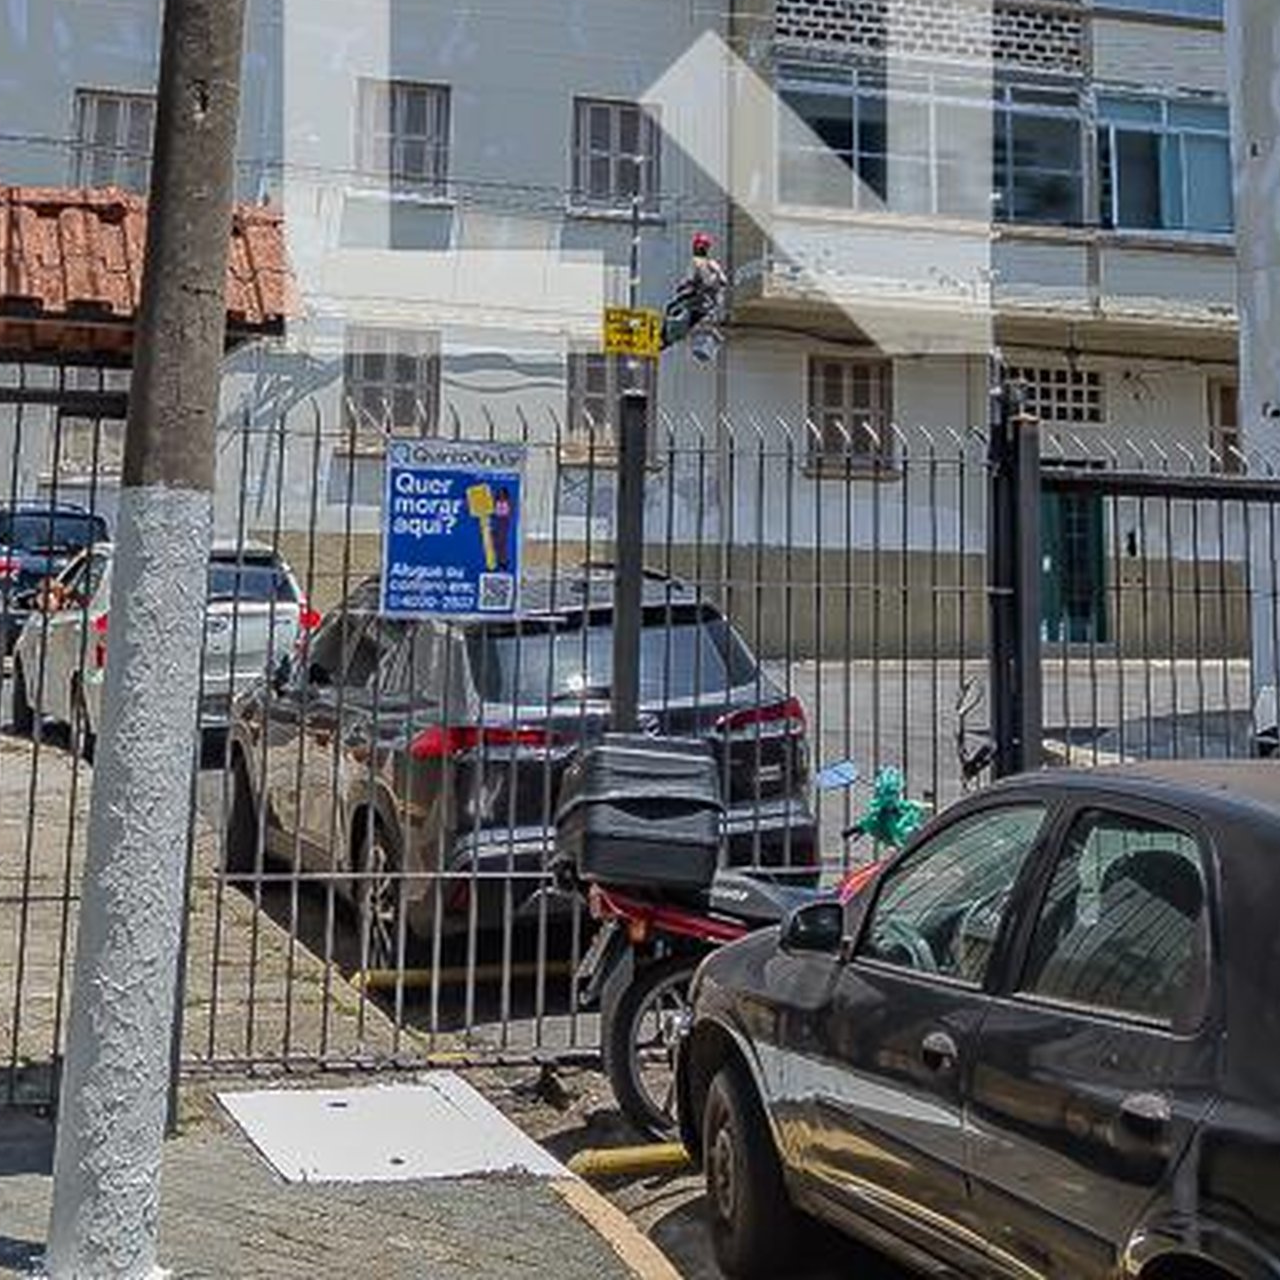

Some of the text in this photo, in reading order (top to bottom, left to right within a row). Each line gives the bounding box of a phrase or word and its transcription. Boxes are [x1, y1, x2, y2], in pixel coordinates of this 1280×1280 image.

[395, 472, 453, 495] Quer
[394, 497, 462, 515] morar
[393, 515, 458, 539] aqui?
